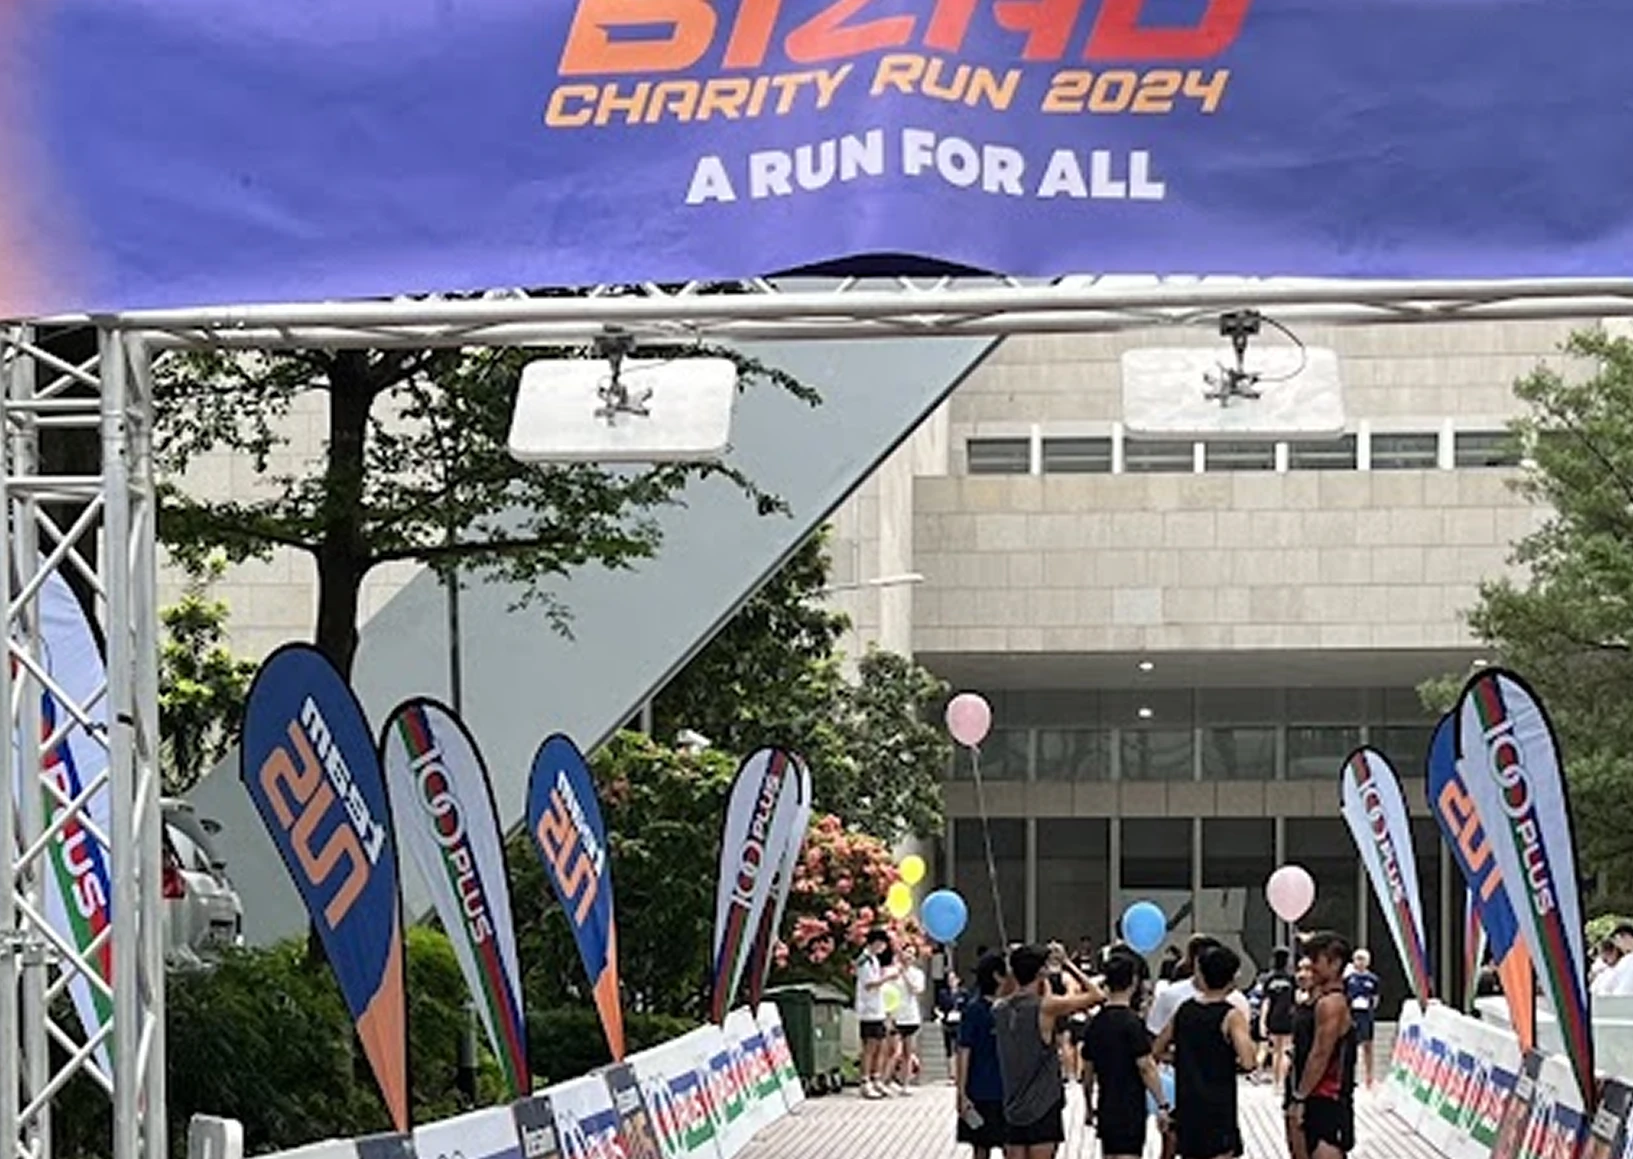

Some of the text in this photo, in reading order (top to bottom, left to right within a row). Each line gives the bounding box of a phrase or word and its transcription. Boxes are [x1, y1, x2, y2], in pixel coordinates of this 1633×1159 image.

[544, 54, 1229, 128] CHARITY RUN 2024
[686, 129, 1166, 204] A RUN FOR ALL
